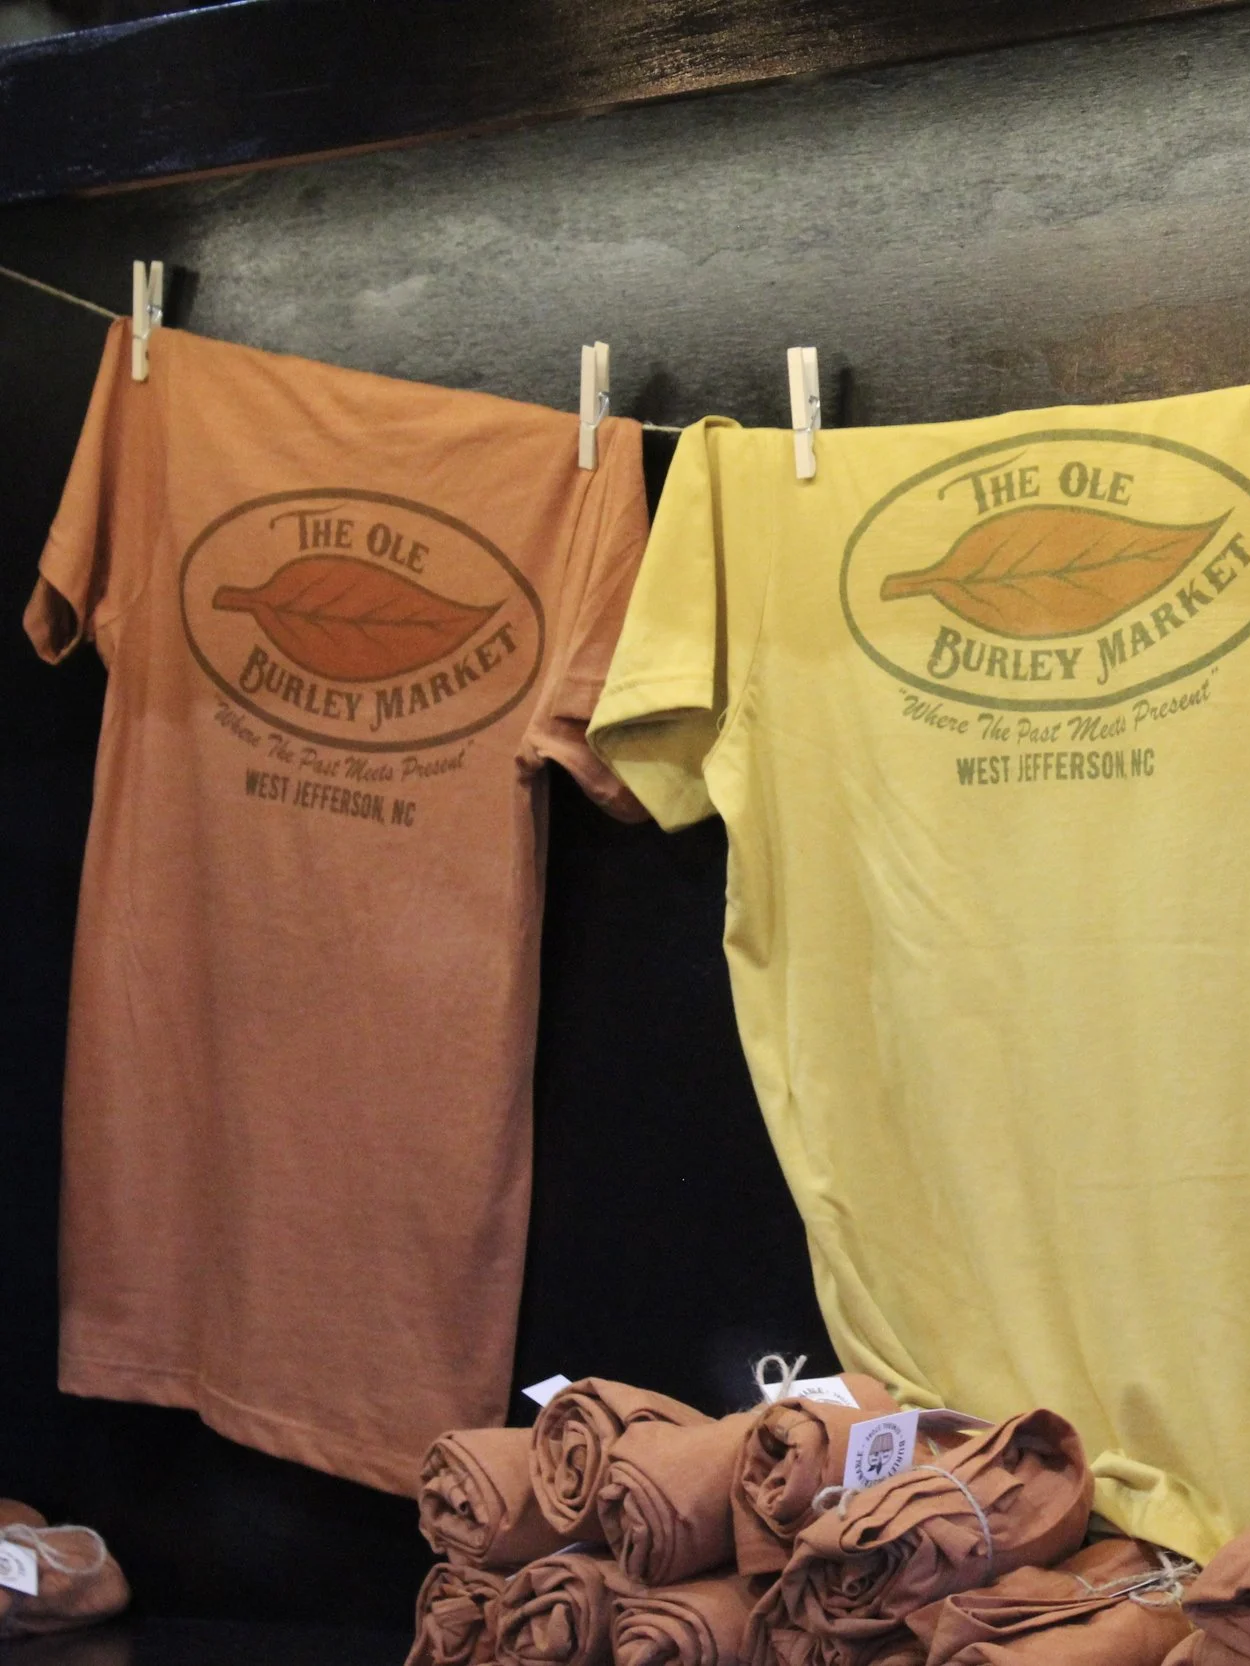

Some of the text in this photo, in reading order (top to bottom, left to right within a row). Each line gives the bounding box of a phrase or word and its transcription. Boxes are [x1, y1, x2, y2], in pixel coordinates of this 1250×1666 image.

[937, 446, 1135, 515] THE OLE
[269, 502, 431, 574] THE OLE
[239, 622, 519, 732] BURLEY MARKET
[926, 624, 1083, 681] BURLEY
[267, 733, 295, 763] The
[299, 747, 342, 777] Past
[345, 756, 393, 782] Meets
[977, 712, 1011, 742] The
[1017, 717, 1062, 745] Past
[1067, 715, 1127, 742] Meets
[956, 748, 1155, 785] WEST JEFFERSON, NC
[245, 768, 416, 827] WEST JEFFERSON, NC
